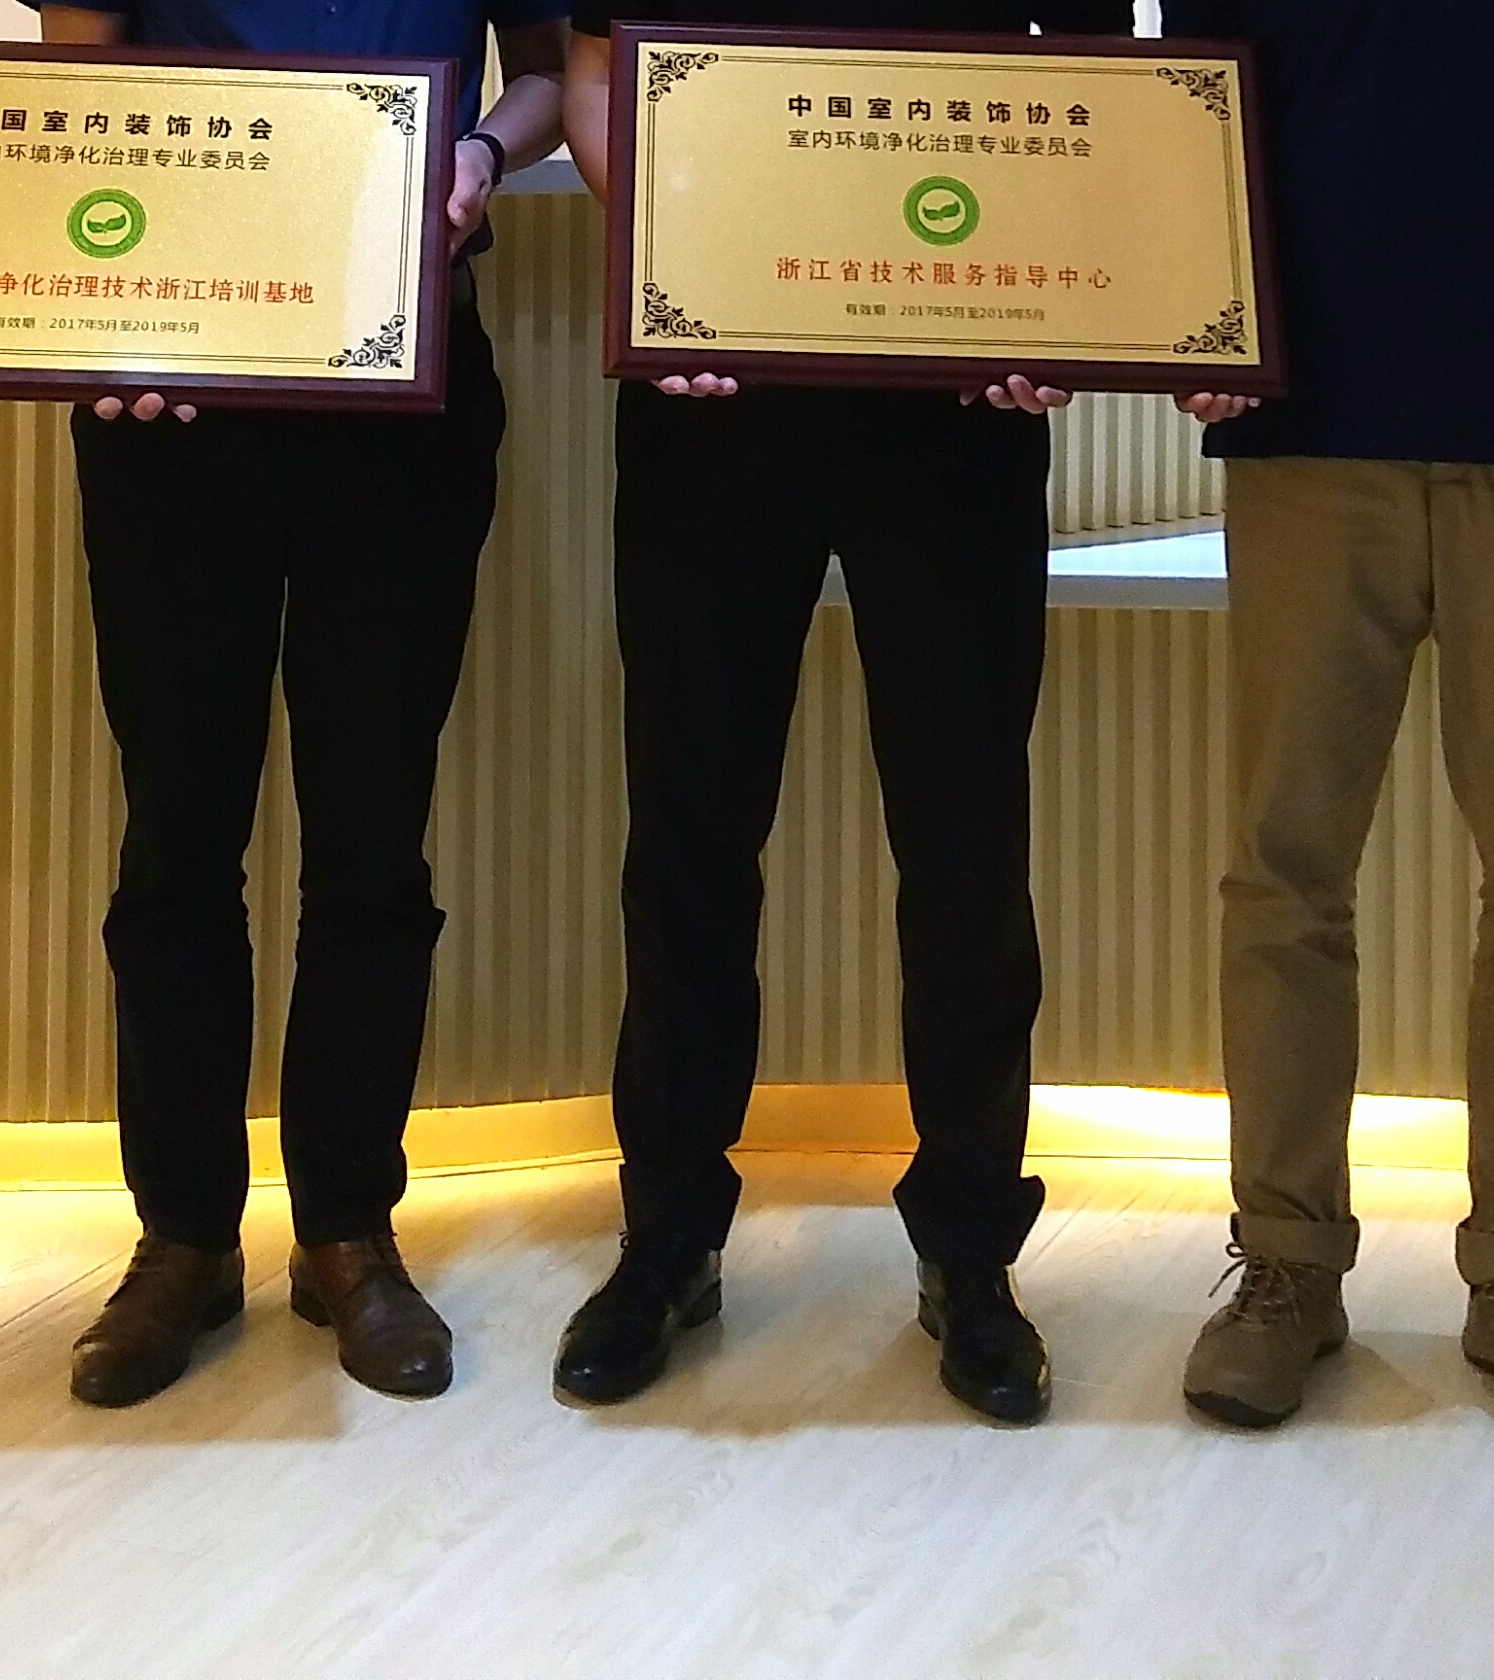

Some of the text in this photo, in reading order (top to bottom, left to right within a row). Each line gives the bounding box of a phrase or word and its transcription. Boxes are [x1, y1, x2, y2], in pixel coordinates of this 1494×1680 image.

[787, 94, 1093, 127] 中国室内装饰协会
[787, 130, 1093, 159] 室内环境净化治理专业委员会
[776, 257, 1113, 290] 浙江省技术服务指导中心
